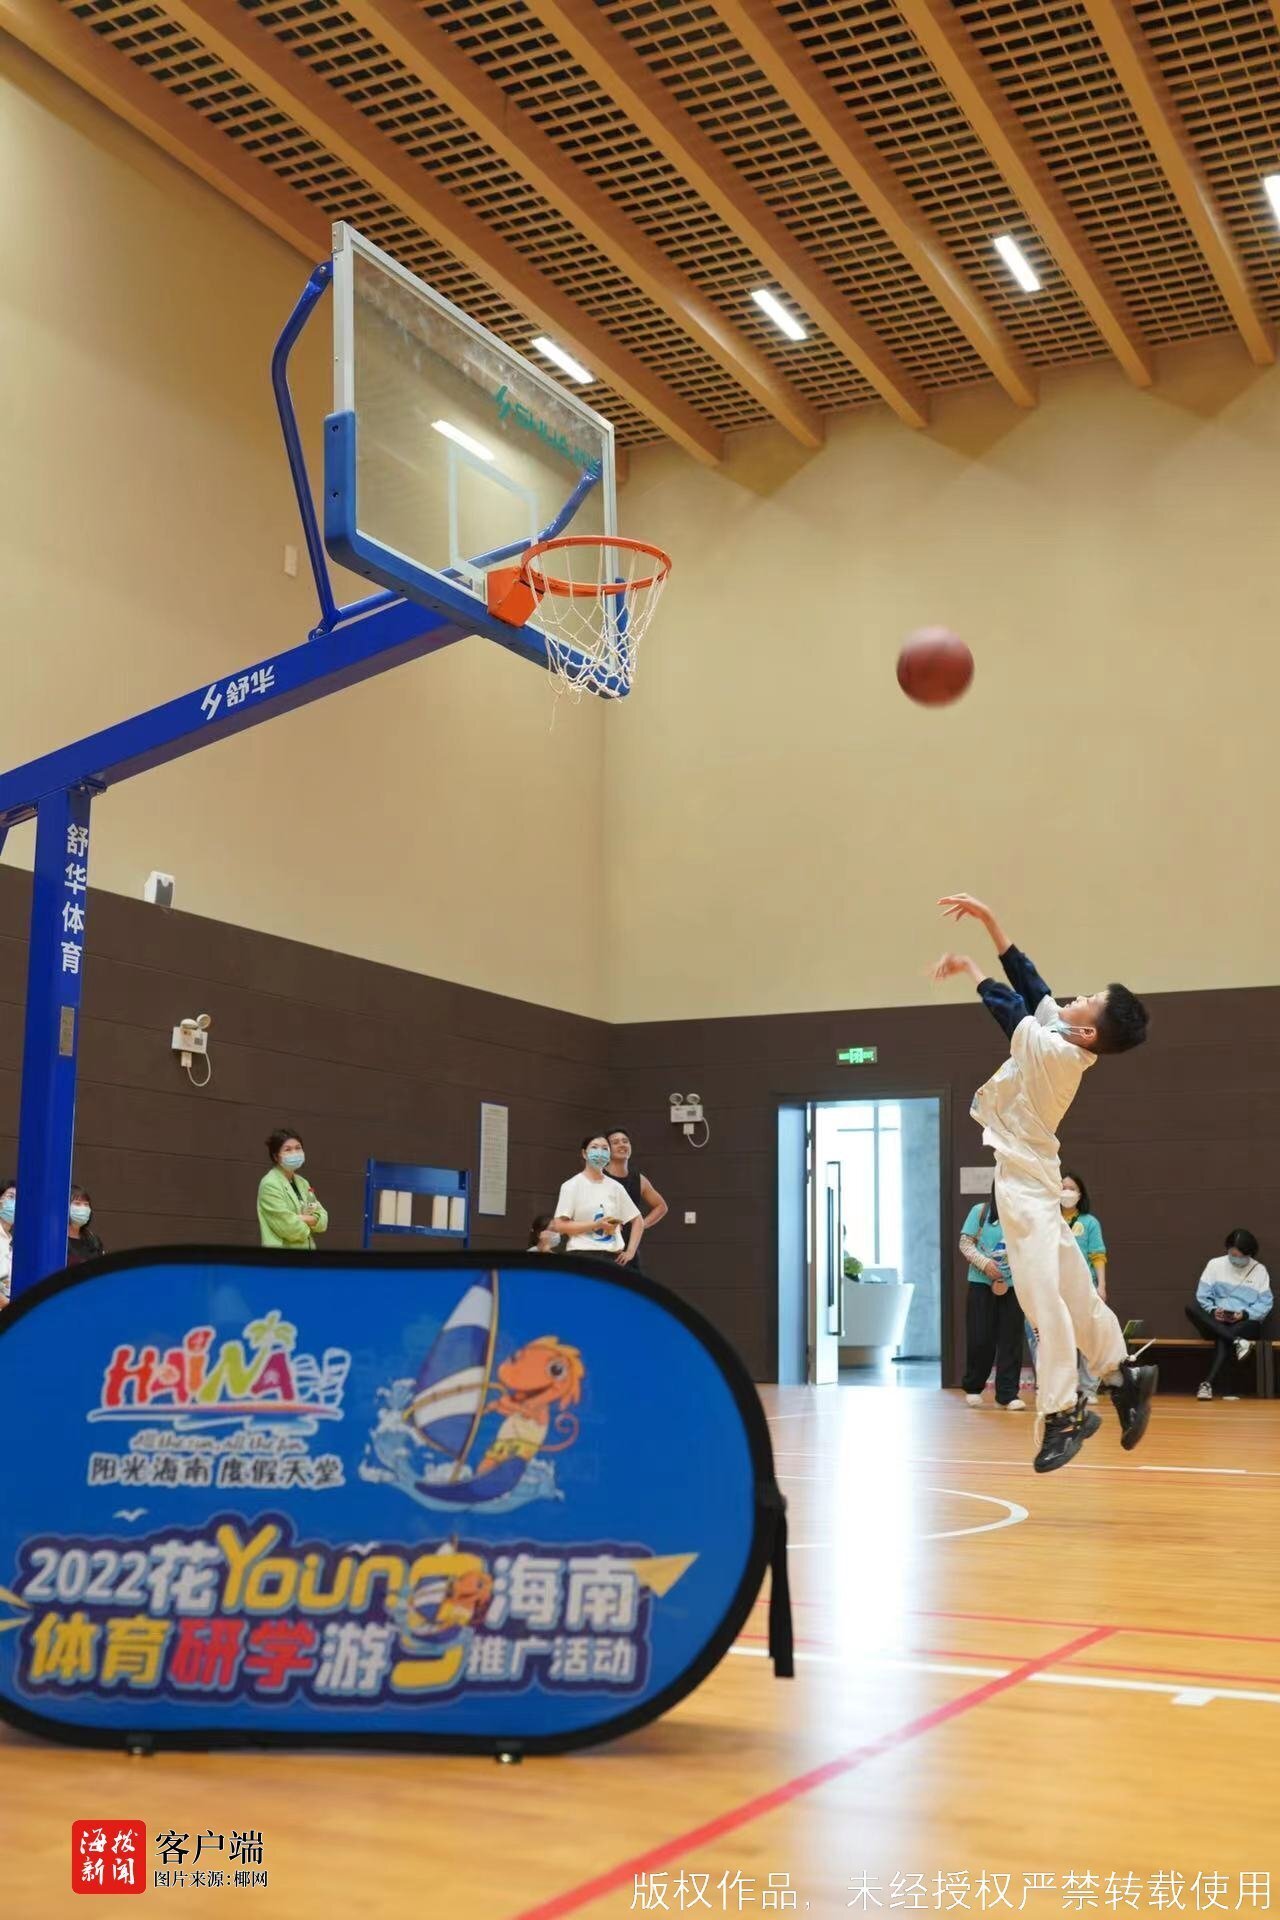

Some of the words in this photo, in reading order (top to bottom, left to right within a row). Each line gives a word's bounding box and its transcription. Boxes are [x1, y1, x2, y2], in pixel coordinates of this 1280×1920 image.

[226, 665, 275, 708] 舒华
[60, 823, 89, 974] 舒华体育
[92, 1457, 209, 1483] 阳光海南
[221, 1459, 340, 1485] 度假天堂
[29, 1612, 392, 1690] 体育研学游
[467, 1638, 636, 1680] 推广活动
